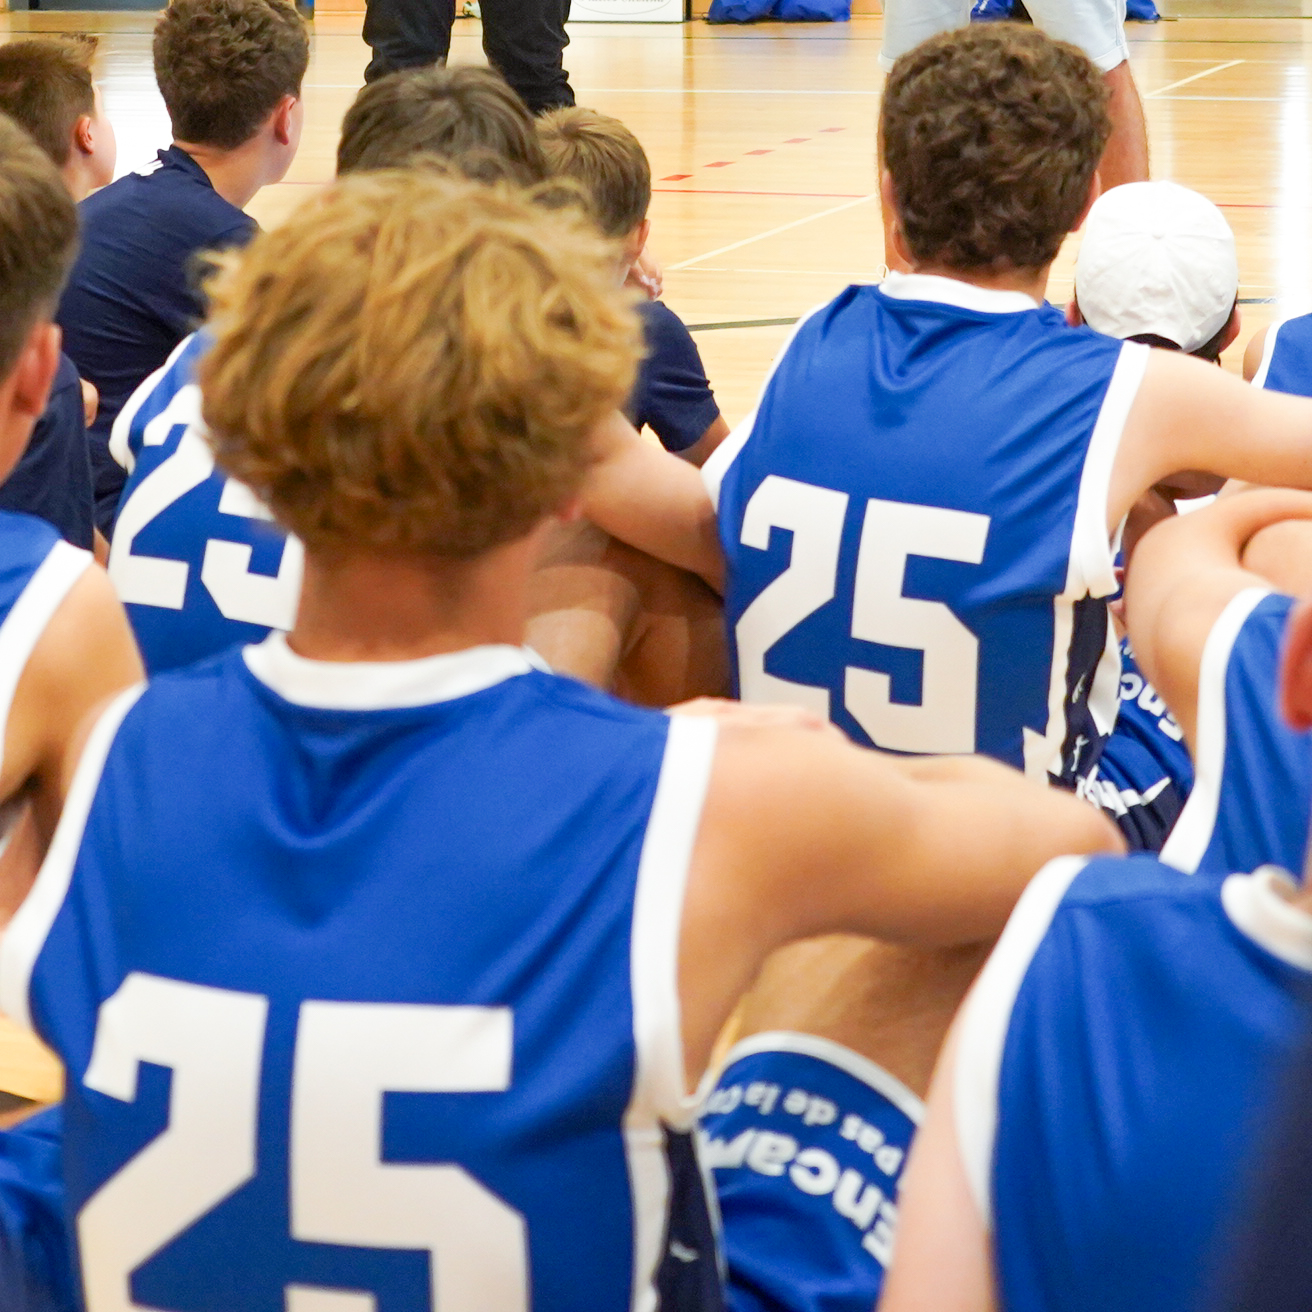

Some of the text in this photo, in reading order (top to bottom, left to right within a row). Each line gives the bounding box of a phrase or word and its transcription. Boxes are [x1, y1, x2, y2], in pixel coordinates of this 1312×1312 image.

[107, 384, 306, 632] 25
[735, 474, 991, 755] 25
[76, 971, 531, 1312] 25
[744, 1079, 781, 1116] la
[783, 1088, 839, 1127] de
[839, 1113, 904, 1177] Pas
